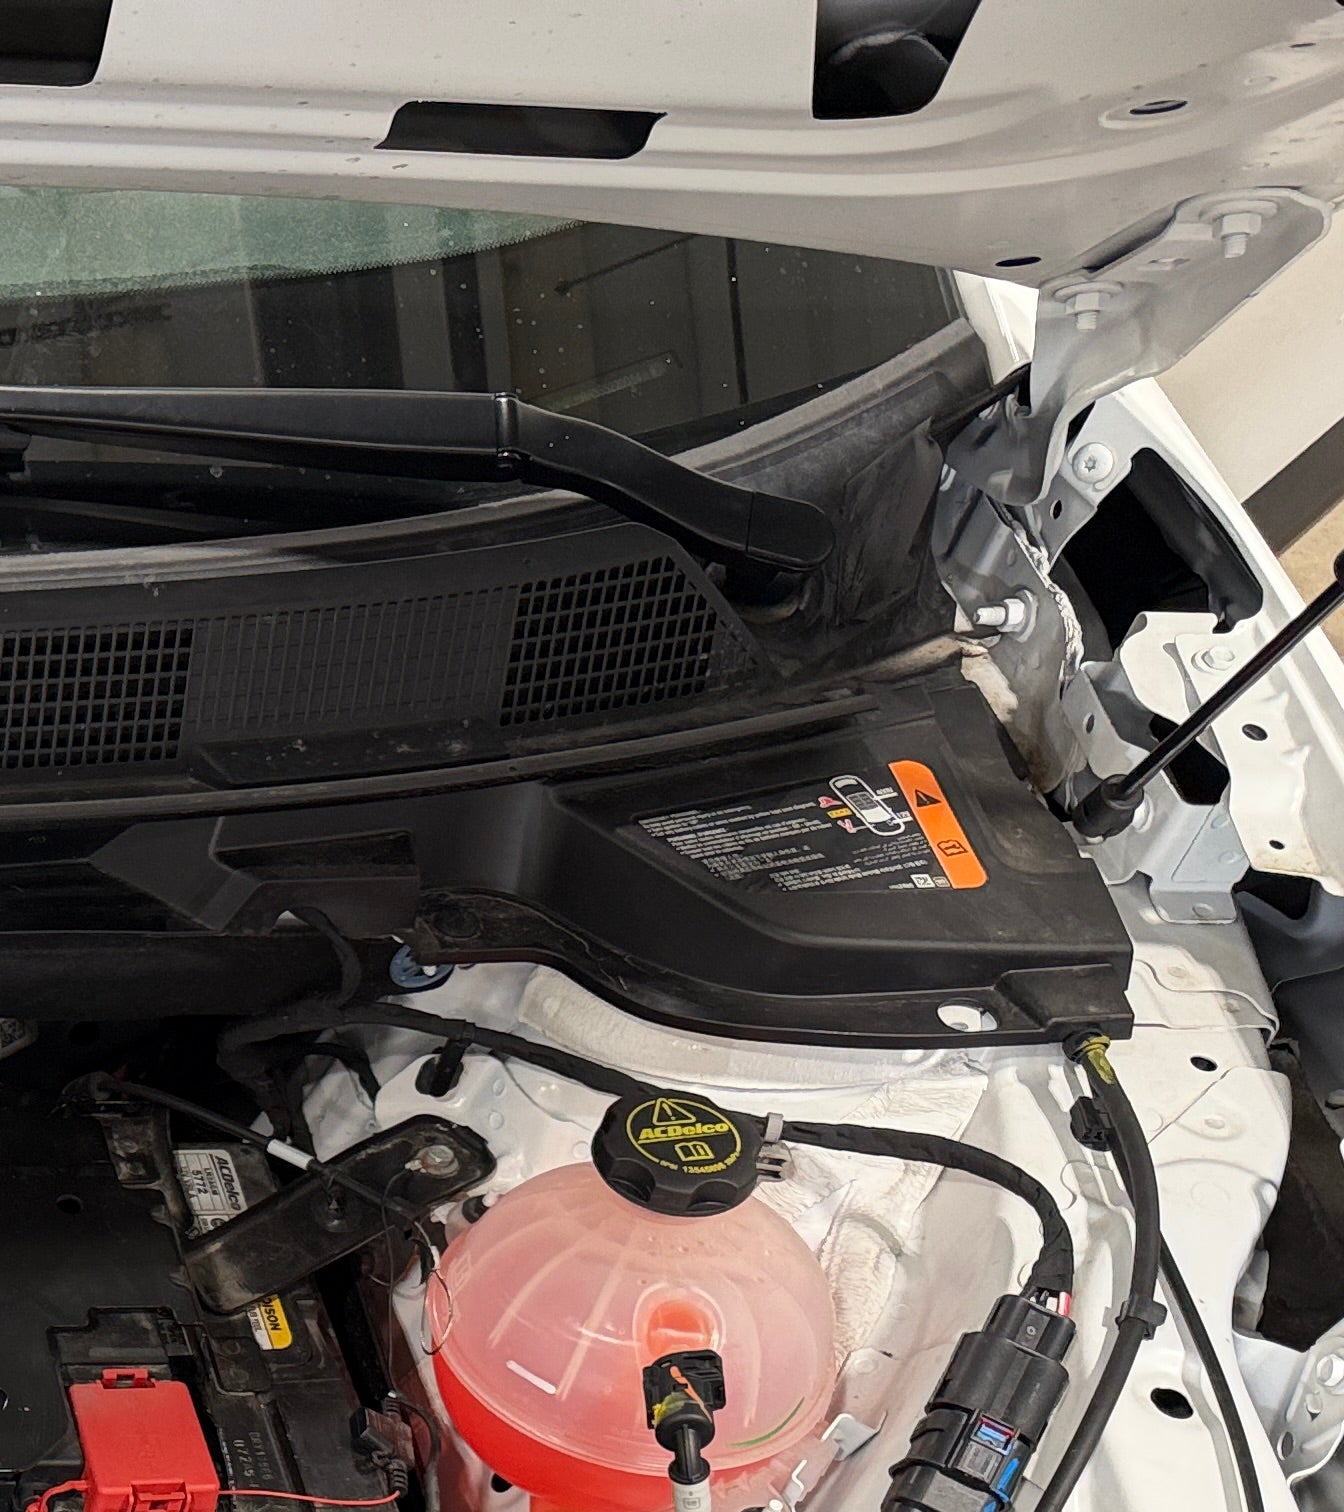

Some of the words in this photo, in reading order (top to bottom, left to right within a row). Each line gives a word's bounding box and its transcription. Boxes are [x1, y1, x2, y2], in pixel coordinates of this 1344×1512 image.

[638, 1121, 731, 1140] ACDelco
[191, 1169, 209, 1195] 5772
[215, 1156, 242, 1211] ACDelco
